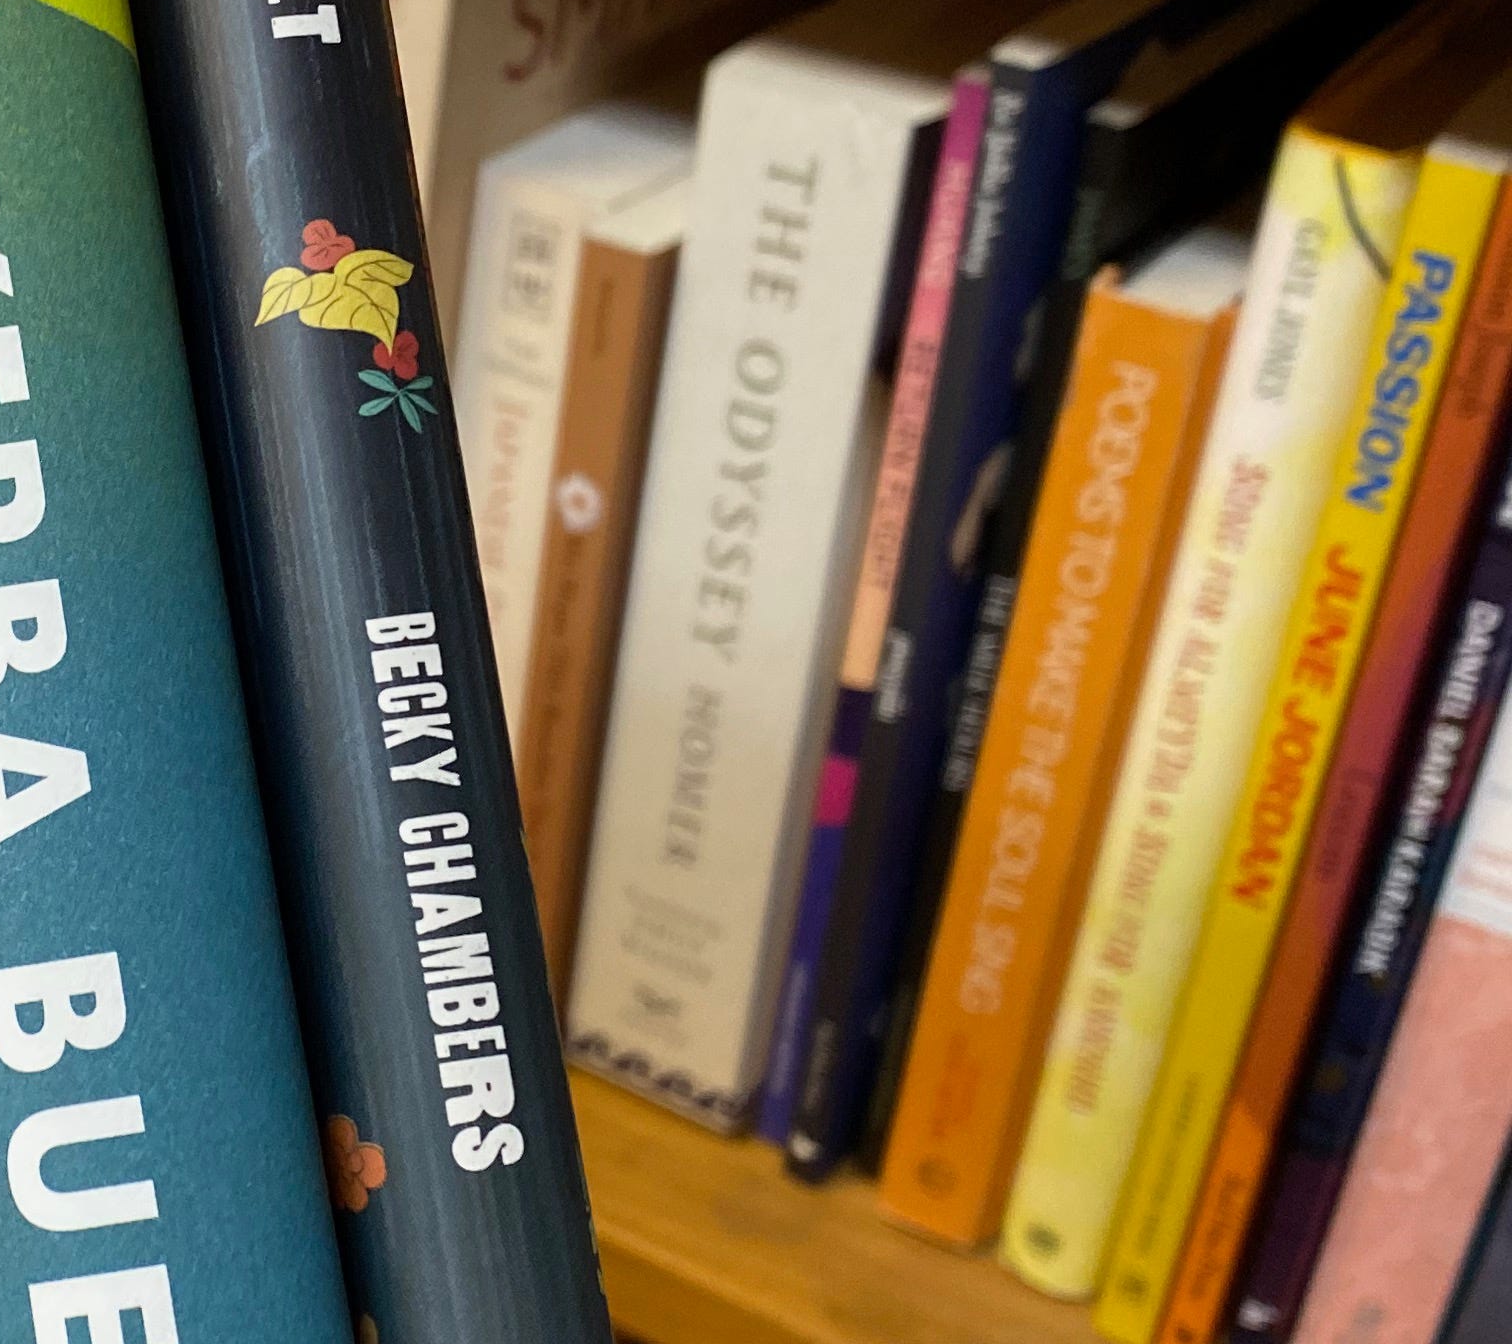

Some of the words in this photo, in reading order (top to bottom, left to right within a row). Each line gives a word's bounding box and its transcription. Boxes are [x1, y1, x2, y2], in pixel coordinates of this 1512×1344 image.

[745, 154, 822, 314] THE
[1068, 356, 1164, 532] POEMS
[1329, 246, 1469, 515] PASSION
[688, 336, 789, 665] ODYSSEY
[1052, 526, 1121, 603] TO
[364, 610, 463, 787] BECKY
[1022, 591, 1101, 722] MAKE
[1288, 540, 1371, 697] JUNE
[659, 683, 724, 870] HOMER
[1002, 719, 1071, 810] THE
[1226, 692, 1326, 913] JORDAN
[975, 804, 1049, 916] SOUL
[397, 810, 526, 1175] CHAMBERS
